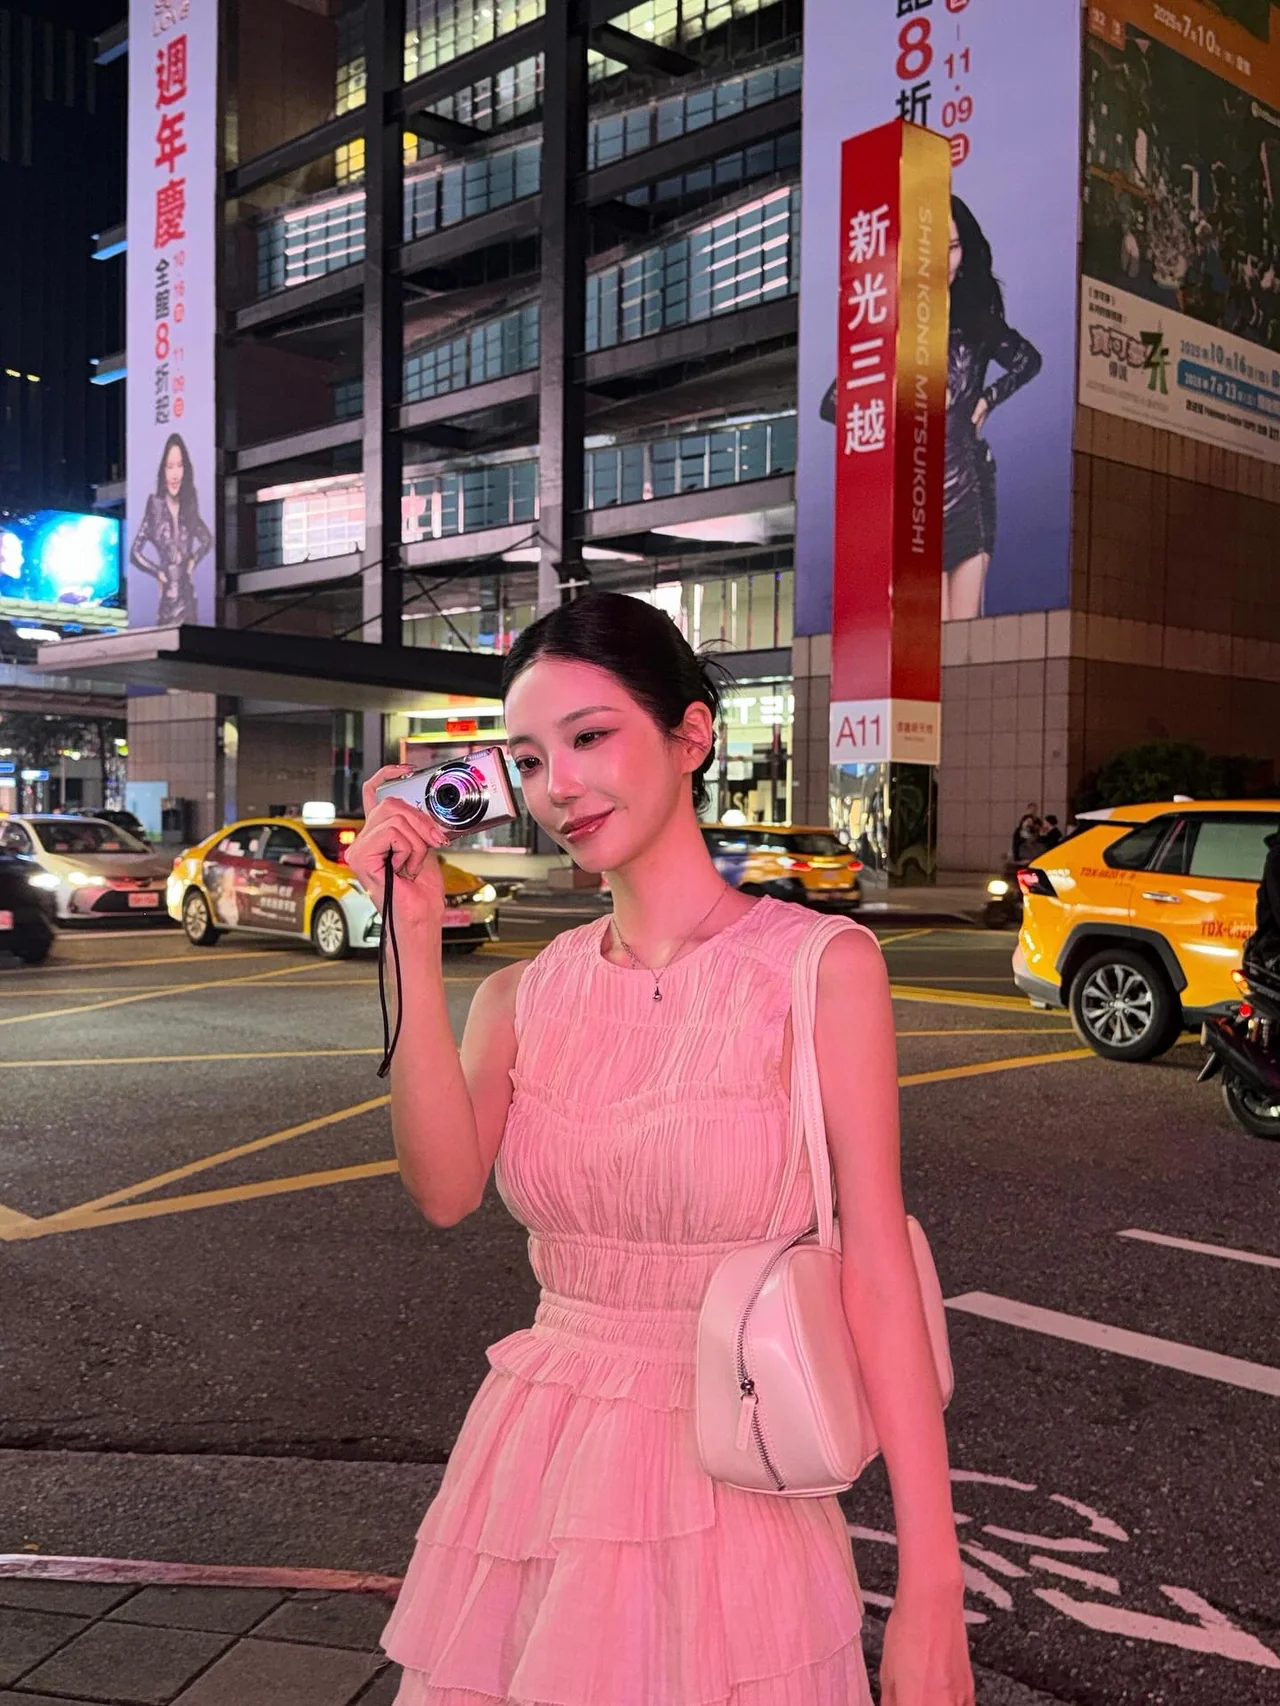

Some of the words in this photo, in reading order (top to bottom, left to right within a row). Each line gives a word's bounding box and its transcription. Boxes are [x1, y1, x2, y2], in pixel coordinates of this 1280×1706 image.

[154, 33, 188, 249] 週年慶
[917, 206, 932, 278] SHIN
[845, 204, 890, 456] 新光三越
[915, 283, 931, 367] KONG
[911, 374, 929, 553] MITSUKOSHI
[836, 714, 881, 748] A11
